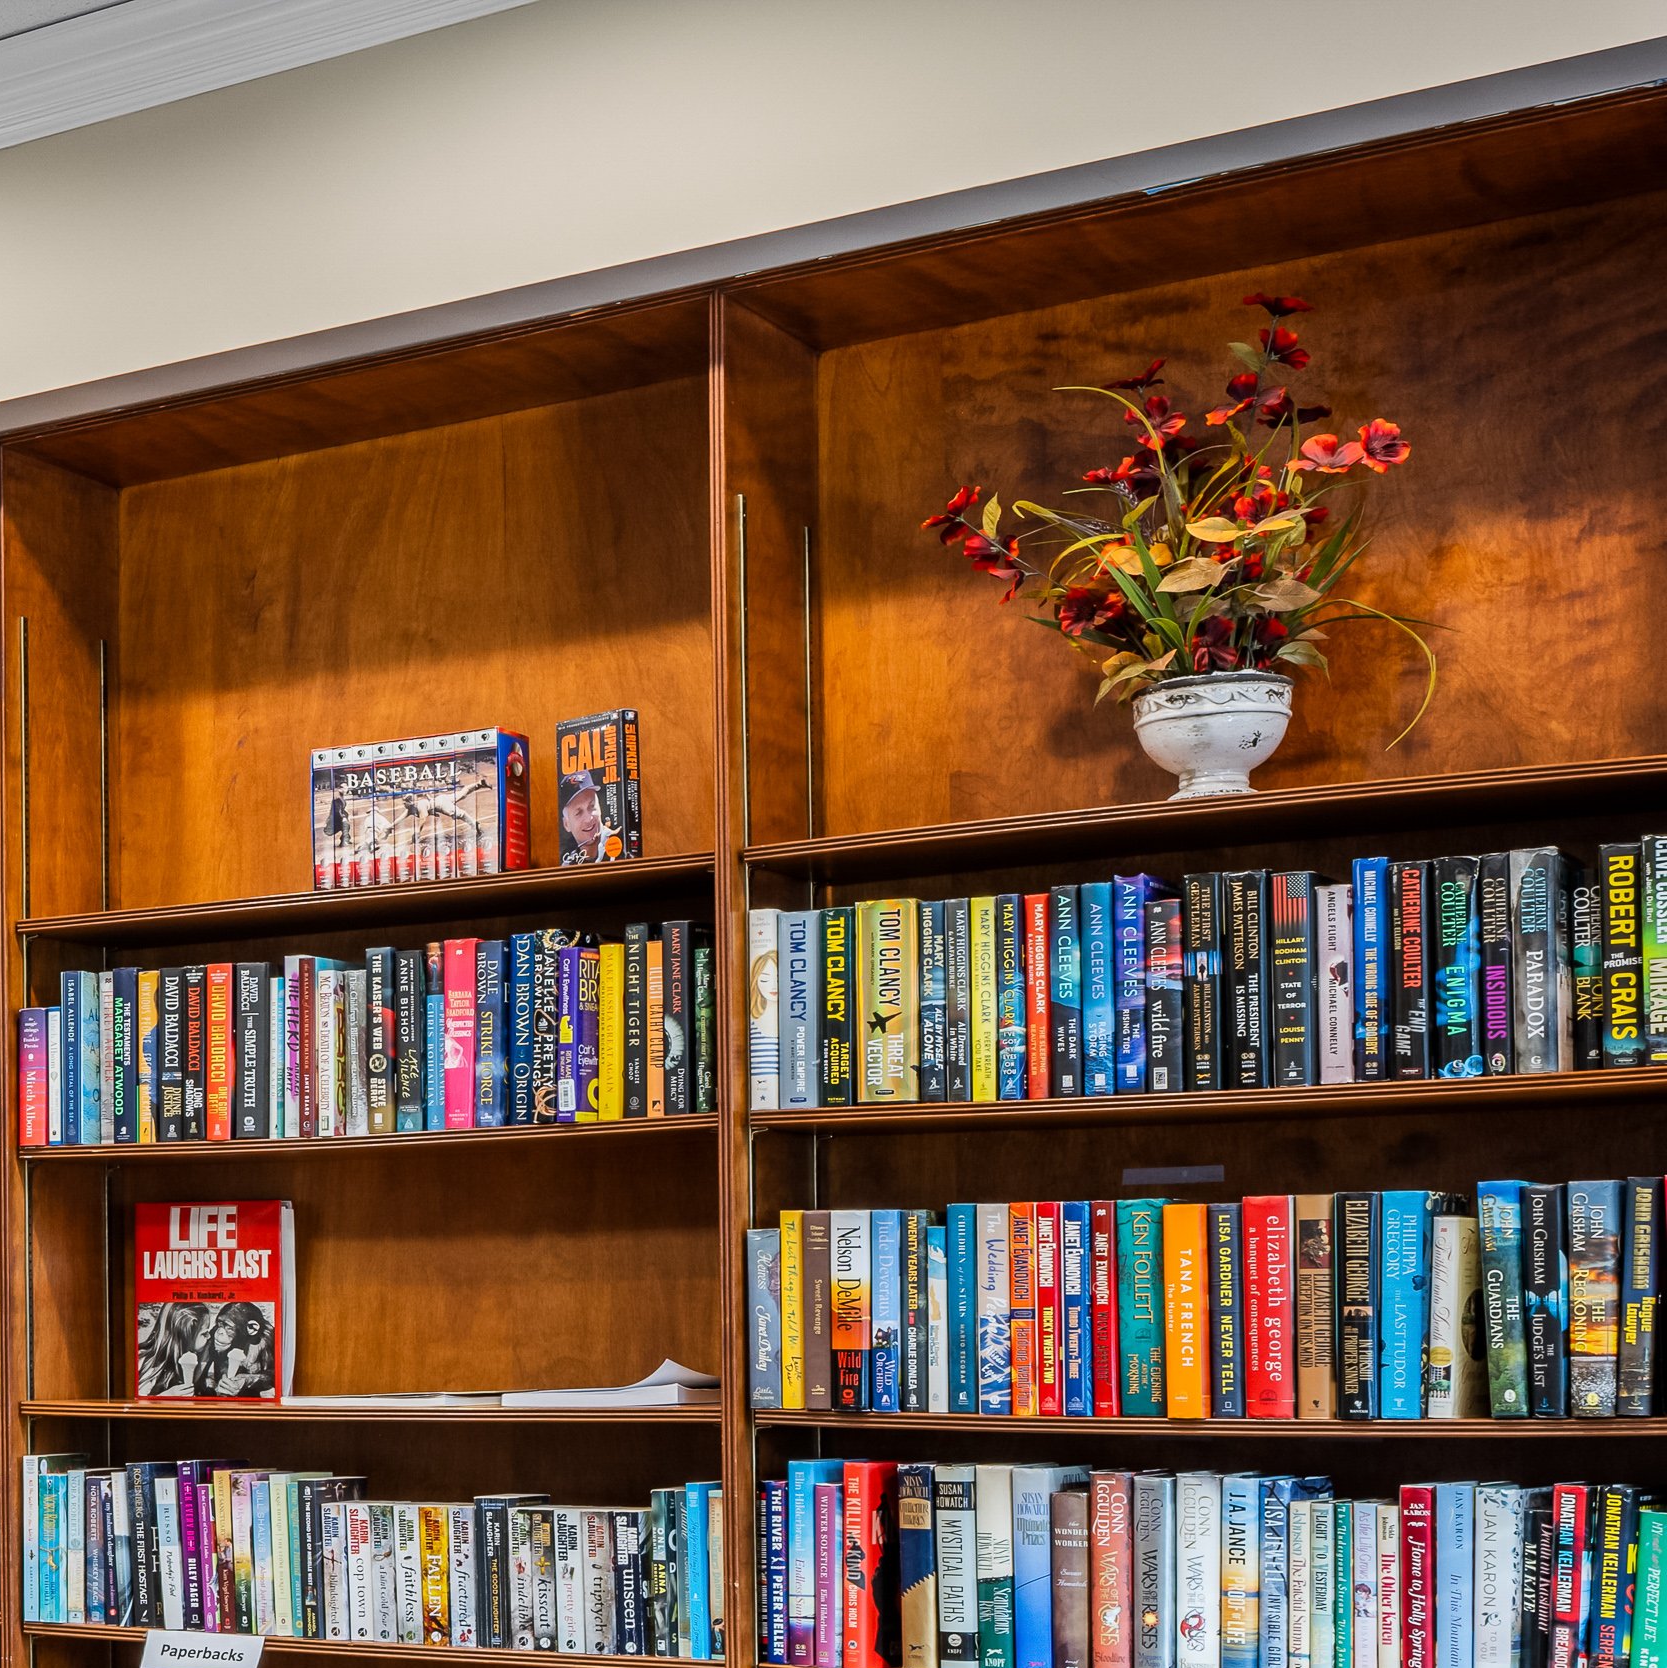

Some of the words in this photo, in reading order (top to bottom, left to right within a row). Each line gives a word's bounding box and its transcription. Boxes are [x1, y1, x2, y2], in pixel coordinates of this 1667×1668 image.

[561, 730, 604, 775] CAL
[604, 725, 617, 766] RIPKEN
[347, 761, 462, 789] BASEBALL
[1231, 882, 1243, 913] JAMES
[1247, 890, 1258, 913] BILL
[1609, 855, 1636, 947] ROBERT
[827, 917, 844, 953] TOM
[879, 909, 901, 941] TOM
[1151, 921, 1166, 944] ANN
[1233, 915, 1244, 970] PATTERSON
[1248, 914, 1258, 959] CLINTON
[516, 939, 530, 977] DAN
[1150, 947, 1167, 991] CLEEVES
[1275, 947, 1307, 955] RODHAM
[1604, 957, 1643, 968] PROMISE
[165, 976, 179, 1011] DAVID
[827, 957, 844, 1022] CLANCY
[879, 948, 901, 1007] CLANCY
[1236, 985, 1245, 994] IS
[1249, 973, 1258, 988] THE
[1526, 950, 1544, 1039] PARADOX
[516, 983, 529, 1046] BROWN
[1151, 1000, 1170, 1031] wild
[1237, 997, 1246, 1037] MISSING
[1249, 990, 1260, 1048] PRESIDENT
[1446, 966, 1467, 1036] ENIGMA
[1611, 972, 1638, 1040] CRAIS
[115, 998, 123, 1061] MARGARET
[165, 1014, 179, 1067] BALDACCI
[1152, 1034, 1167, 1058] fire
[831, 1038, 839, 1085] ACQUIRED
[840, 1042, 849, 1079] TARGET
[867, 1039, 883, 1086] VECTOR
[887, 1032, 904, 1079] THREAT
[115, 1065, 123, 1115] ATWOOD
[169, 1205, 238, 1249] LIFE
[1132, 1212, 1150, 1245] KEN
[1219, 1215, 1230, 1242] LISA
[1572, 1193, 1588, 1252] GRISHAM
[1590, 1205, 1606, 1239] JOHN
[144, 1250, 217, 1279] LAUGHS
[222, 1250, 271, 1279] LAST
[837, 1226, 861, 1272] Nelson
[1267, 1216, 1286, 1307] elizabeth
[1134, 1251, 1153, 1323] FOLLETT
[1180, 1249, 1192, 1293] TANA
[1219, 1248, 1232, 1306] GARDNER
[837, 1278, 862, 1331] DeMille
[1487, 1269, 1503, 1349] GUARDIANS
[1573, 1269, 1589, 1352] RECKONING
[1591, 1298, 1605, 1322] THE
[1181, 1303, 1193, 1367] FRENCH
[1221, 1316, 1233, 1357] NEVER
[1264, 1317, 1282, 1381] george
[838, 1352, 861, 1368] Wild
[840, 1370, 859, 1386] Fire
[1222, 1363, 1234, 1394] TELL
[771, 1490, 781, 1511] THE
[557, 1513, 568, 1562] SLAUGHTER
[567, 1525, 578, 1550] KARIN
[771, 1516, 782, 1550] RIVER
[941, 1520, 963, 1579] MYSTICAL
[1408, 1536, 1425, 1576] Home
[401, 1565, 417, 1622] faithless
[427, 1554, 442, 1618] FALLEN
[623, 1569, 635, 1629] unseen
[773, 1576, 783, 1610] PETER
[943, 1586, 964, 1623] PATHS
[1412, 1579, 1423, 1590] to
[1408, 1590, 1425, 1626] Holly
[161, 1644, 244, 1662] Paperbacks
[773, 1615, 783, 1656] HELLER
